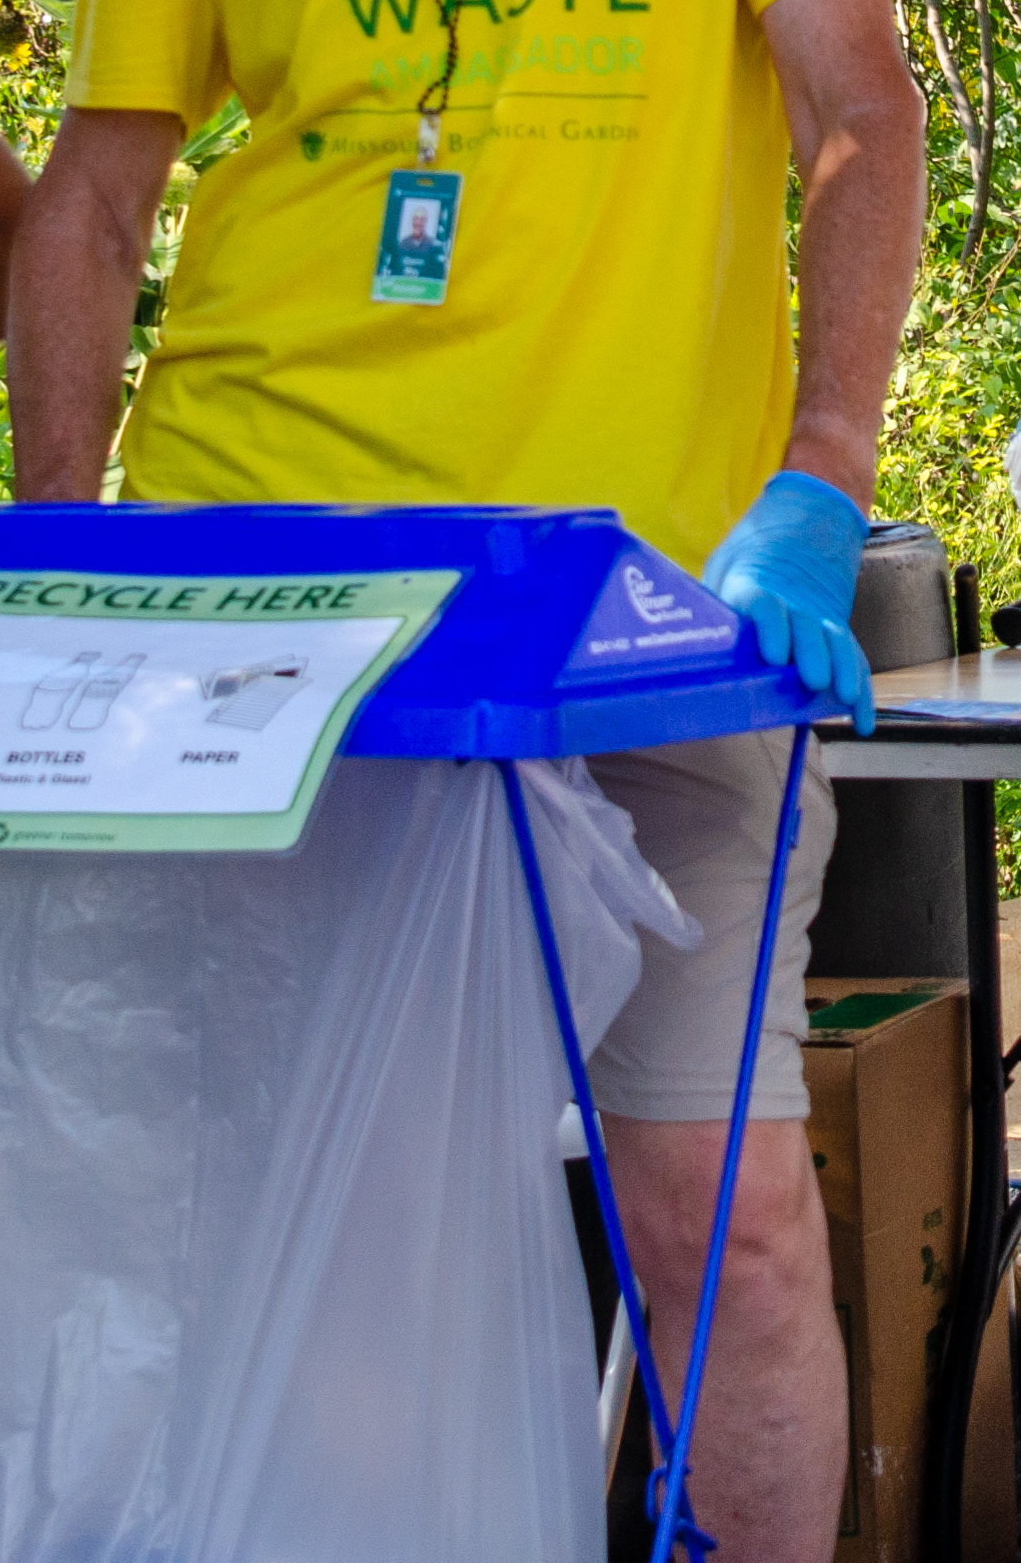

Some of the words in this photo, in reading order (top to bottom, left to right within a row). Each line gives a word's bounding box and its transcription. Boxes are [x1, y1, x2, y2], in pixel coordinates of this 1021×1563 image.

[371, 35, 645, 90] AMBASADOR
[215, 582, 371, 611] HERE
[5, 749, 87, 765] BOTTLES
[180, 750, 241, 765] PAPER
